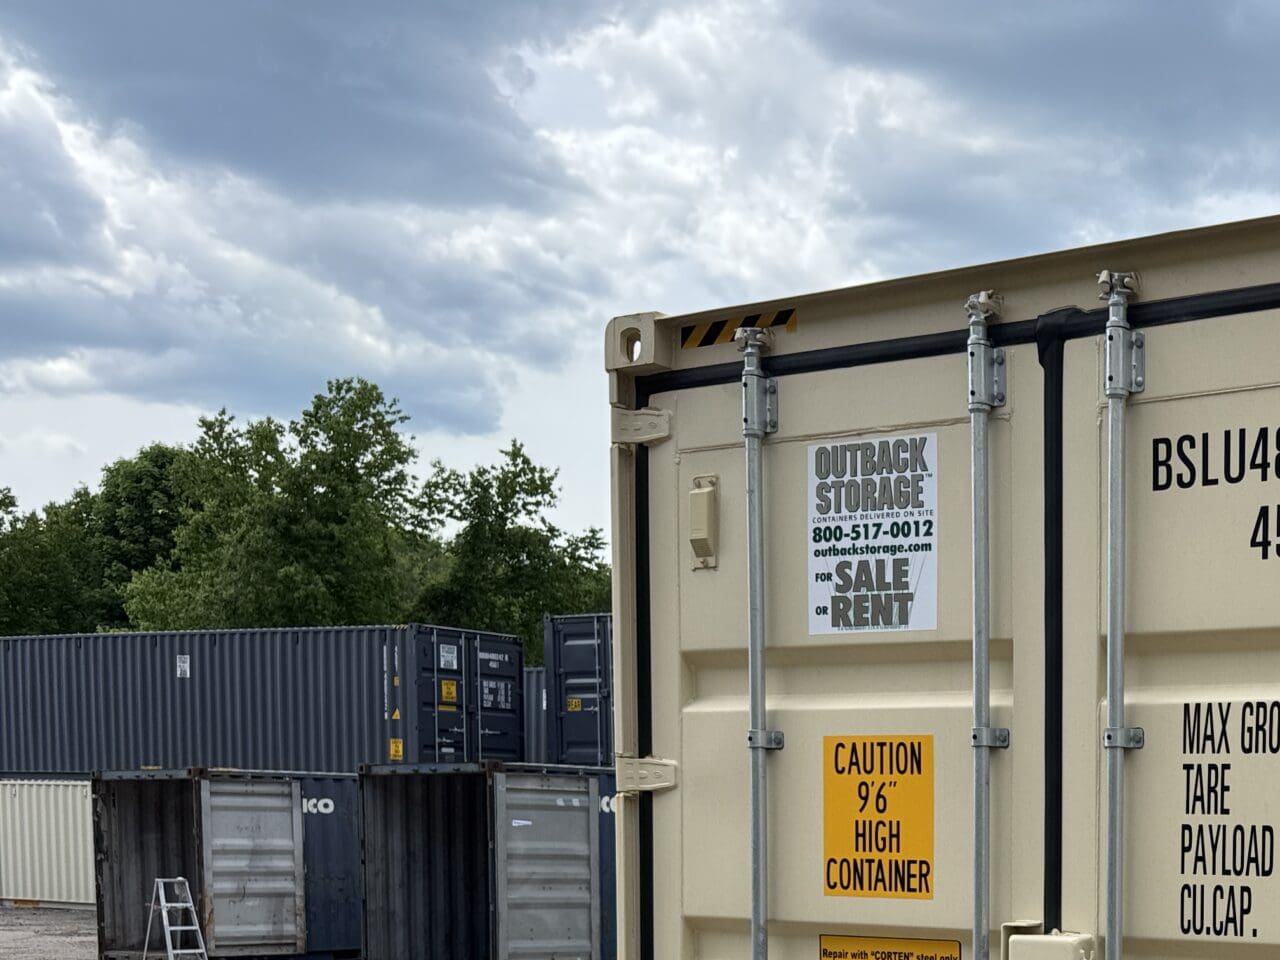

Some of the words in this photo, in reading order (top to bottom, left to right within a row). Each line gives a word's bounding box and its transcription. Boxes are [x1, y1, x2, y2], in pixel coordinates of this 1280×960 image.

[815, 436, 929, 481] OUTBACK
[815, 473, 925, 515] STORAGE
[812, 512, 858, 524] CONTAINERS
[860, 509, 900, 520] DELIVERED
[917, 509, 934, 517] SITE
[812, 519, 934, 543] 800-517-0012
[813, 542, 932, 558] outbackstorage.com
[815, 572, 833, 582] FOR
[835, 557, 910, 594] SALE
[815, 605, 829, 616] OR
[831, 592, 914, 628] RENT
[1182, 702, 1231, 755] MAX
[834, 742, 922, 775] CAUTION
[1182, 763, 1231, 815] TARE
[855, 820, 901, 853] HIGH
[1180, 823, 1274, 877] PAYLOAD
[826, 858, 931, 893] CONTAINER
[1180, 883, 1258, 937] CU.CAP.
[822, 948, 848, 960] Repair
[850, 950, 869, 960] with
